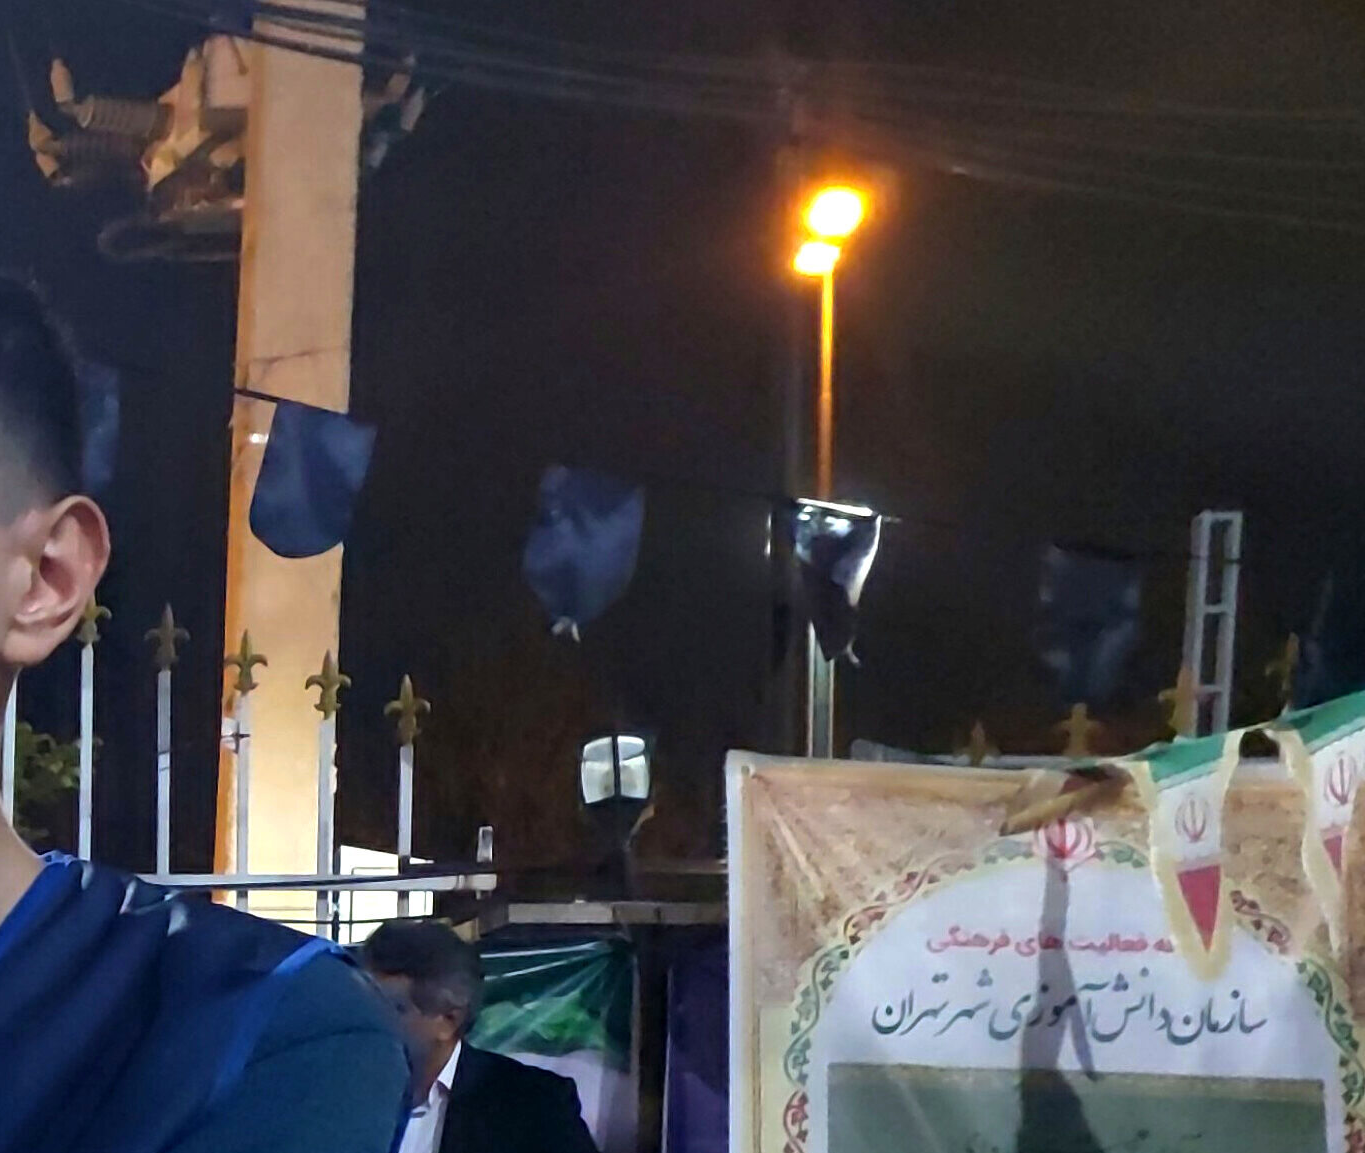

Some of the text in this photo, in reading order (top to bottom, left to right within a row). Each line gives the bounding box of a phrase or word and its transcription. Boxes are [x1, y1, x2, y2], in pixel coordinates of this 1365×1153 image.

[926, 925, 1011, 956] فرهنگی
[871, 966, 1268, 1046] سازمان دانش آموزی شهر تهران
